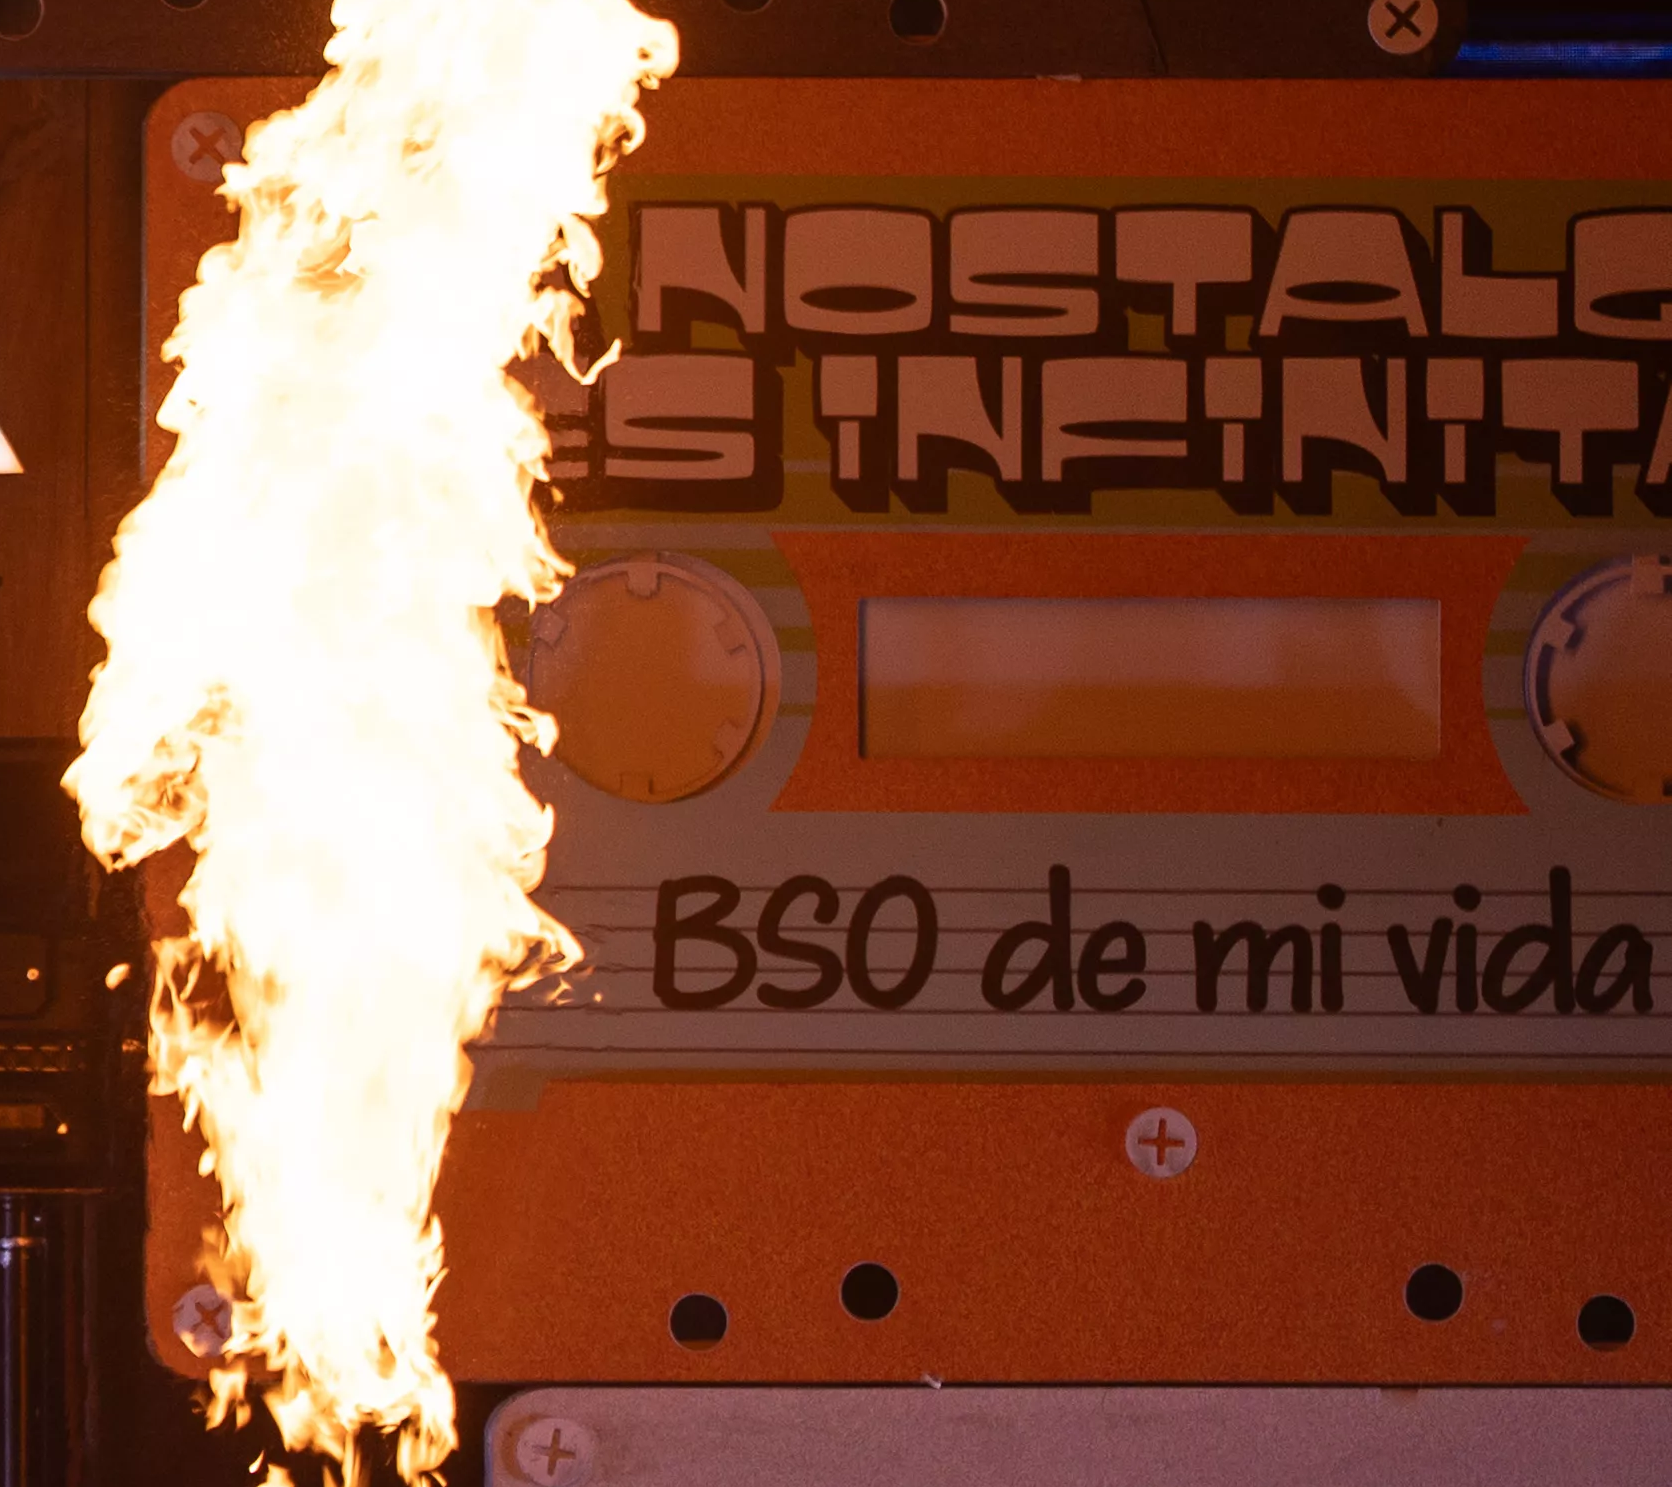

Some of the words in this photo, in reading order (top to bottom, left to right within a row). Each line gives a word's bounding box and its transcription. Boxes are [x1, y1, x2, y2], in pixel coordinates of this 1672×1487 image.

[651, 874, 937, 1010] BSO
[981, 865, 1147, 1012] de
[1193, 883, 1343, 1014] mi
[1387, 866, 1654, 1014] vida
